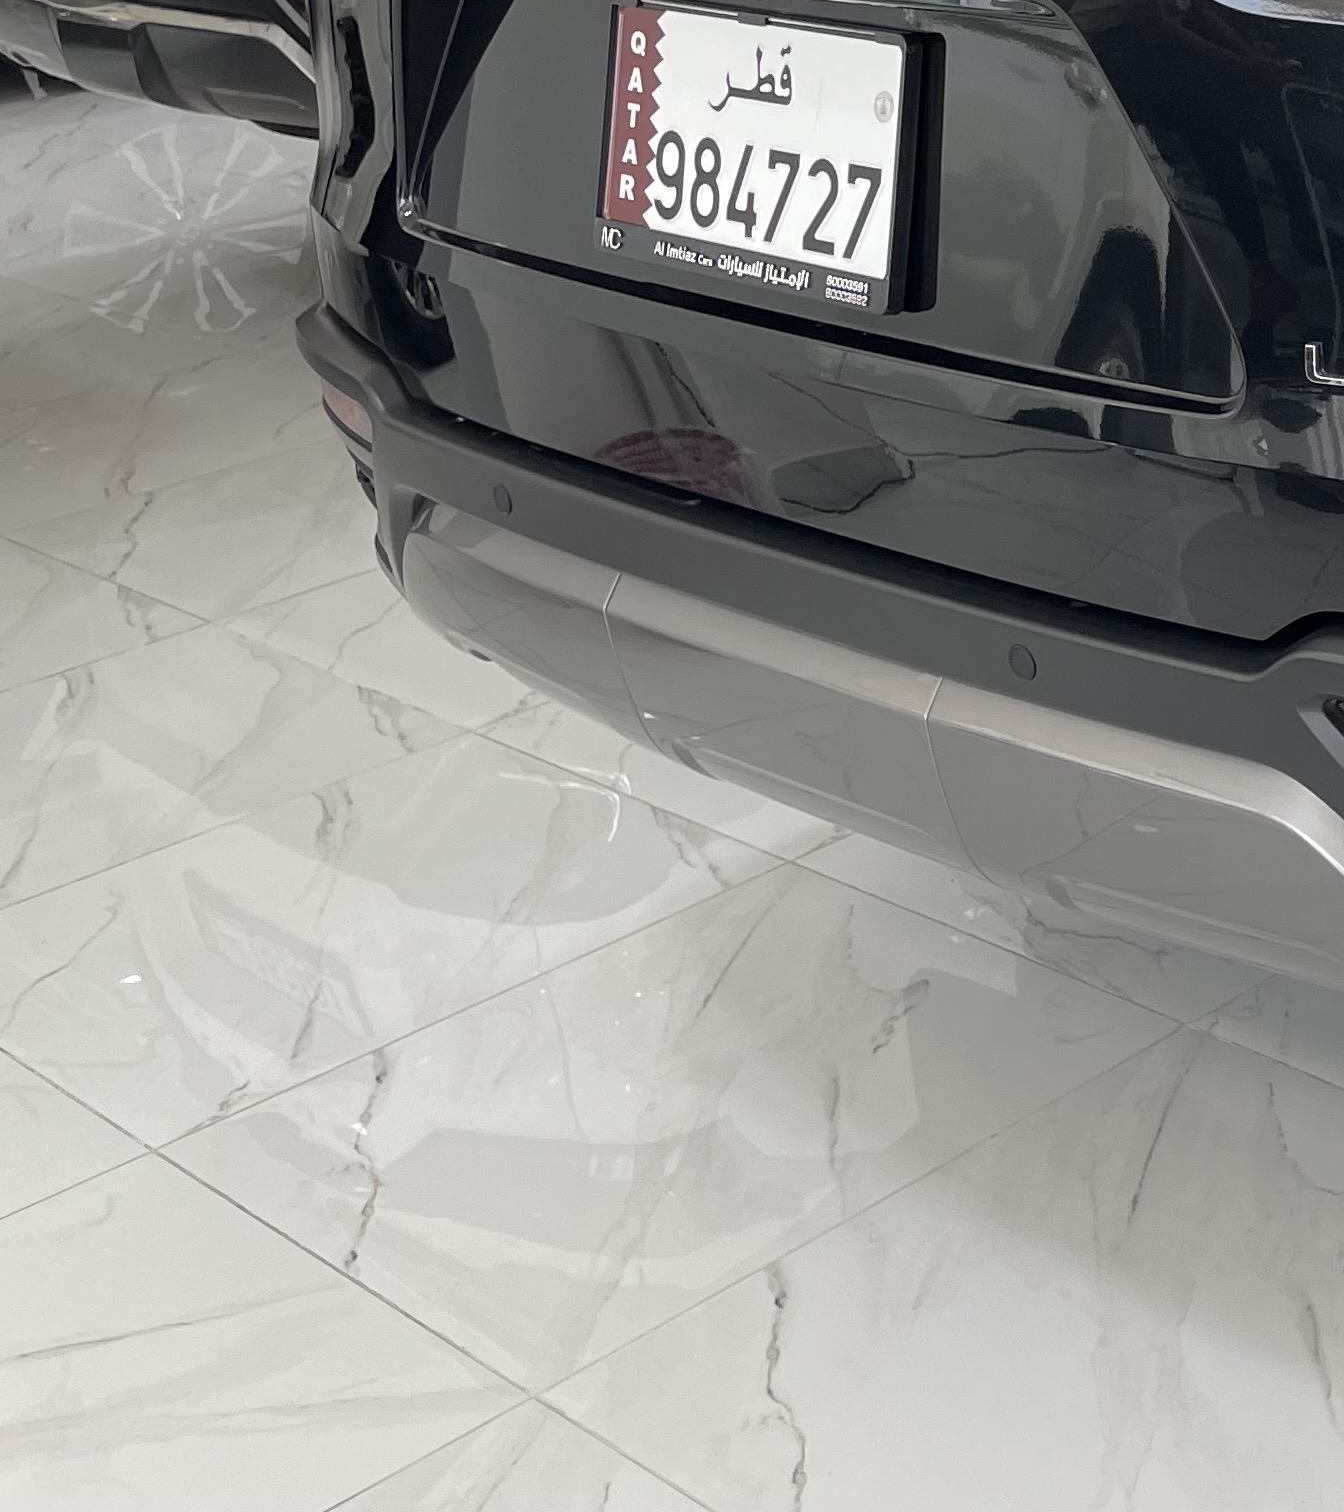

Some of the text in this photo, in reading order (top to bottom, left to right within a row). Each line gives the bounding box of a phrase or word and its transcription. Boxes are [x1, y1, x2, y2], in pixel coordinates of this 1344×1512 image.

[707, 44, 793, 112] قطر
[618, 30, 647, 202] QATAR
[653, 130, 882, 259] 984727
[653, 241, 665, 256] Al
[666, 243, 698, 264] Imtiaz
[717, 254, 764, 278] للسيارات
